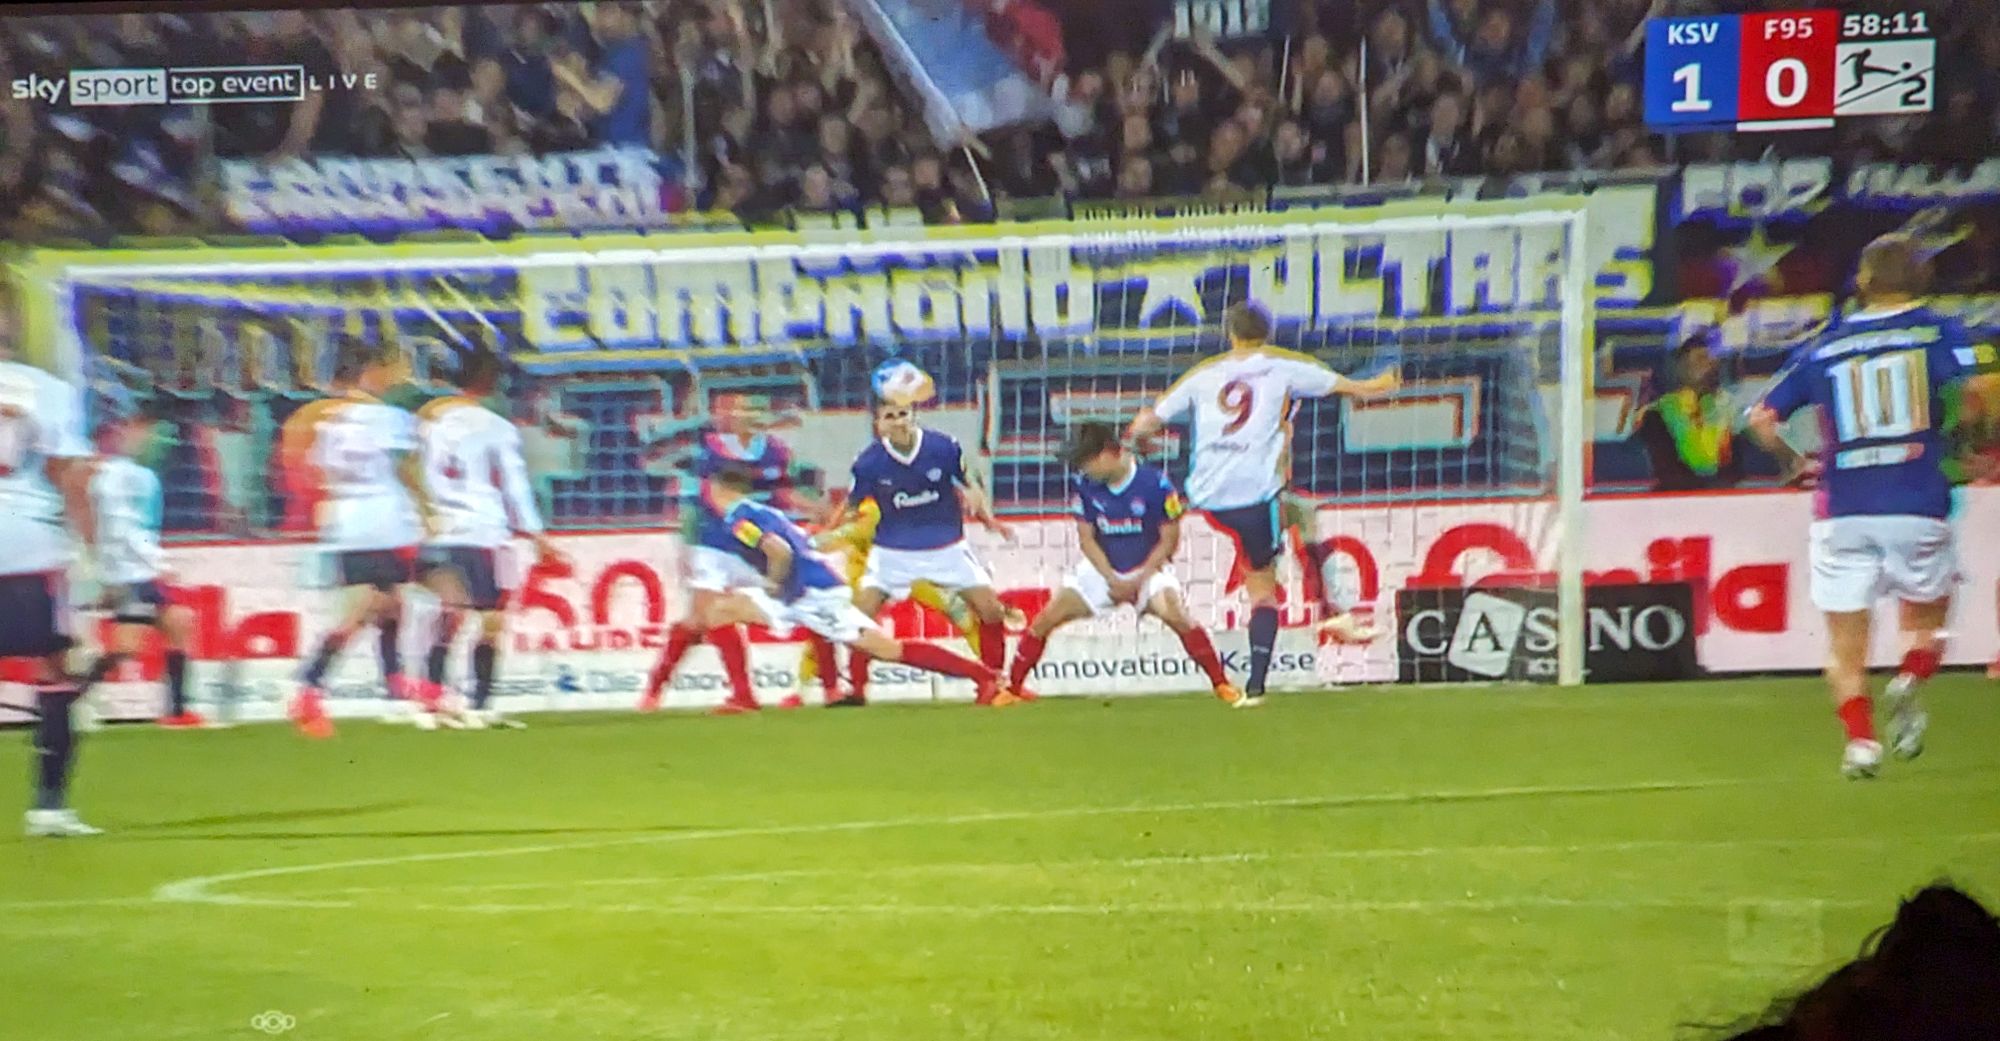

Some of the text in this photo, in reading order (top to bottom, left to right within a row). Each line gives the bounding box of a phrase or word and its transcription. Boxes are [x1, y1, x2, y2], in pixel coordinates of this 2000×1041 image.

[1668, 22, 1719, 45] KSV
[1764, 18, 1813, 40] F95
[1843, 12, 1929, 36] 58:11
[11, 72, 378, 104] sky sport top event LIVE
[1671, 62, 1713, 112] 1
[1765, 57, 1809, 108] 0
[1899, 74, 1927, 106] 2
[1217, 380, 1254, 436] 9
[1826, 350, 1926, 441] 10
[1406, 603, 1686, 656] CASNO
